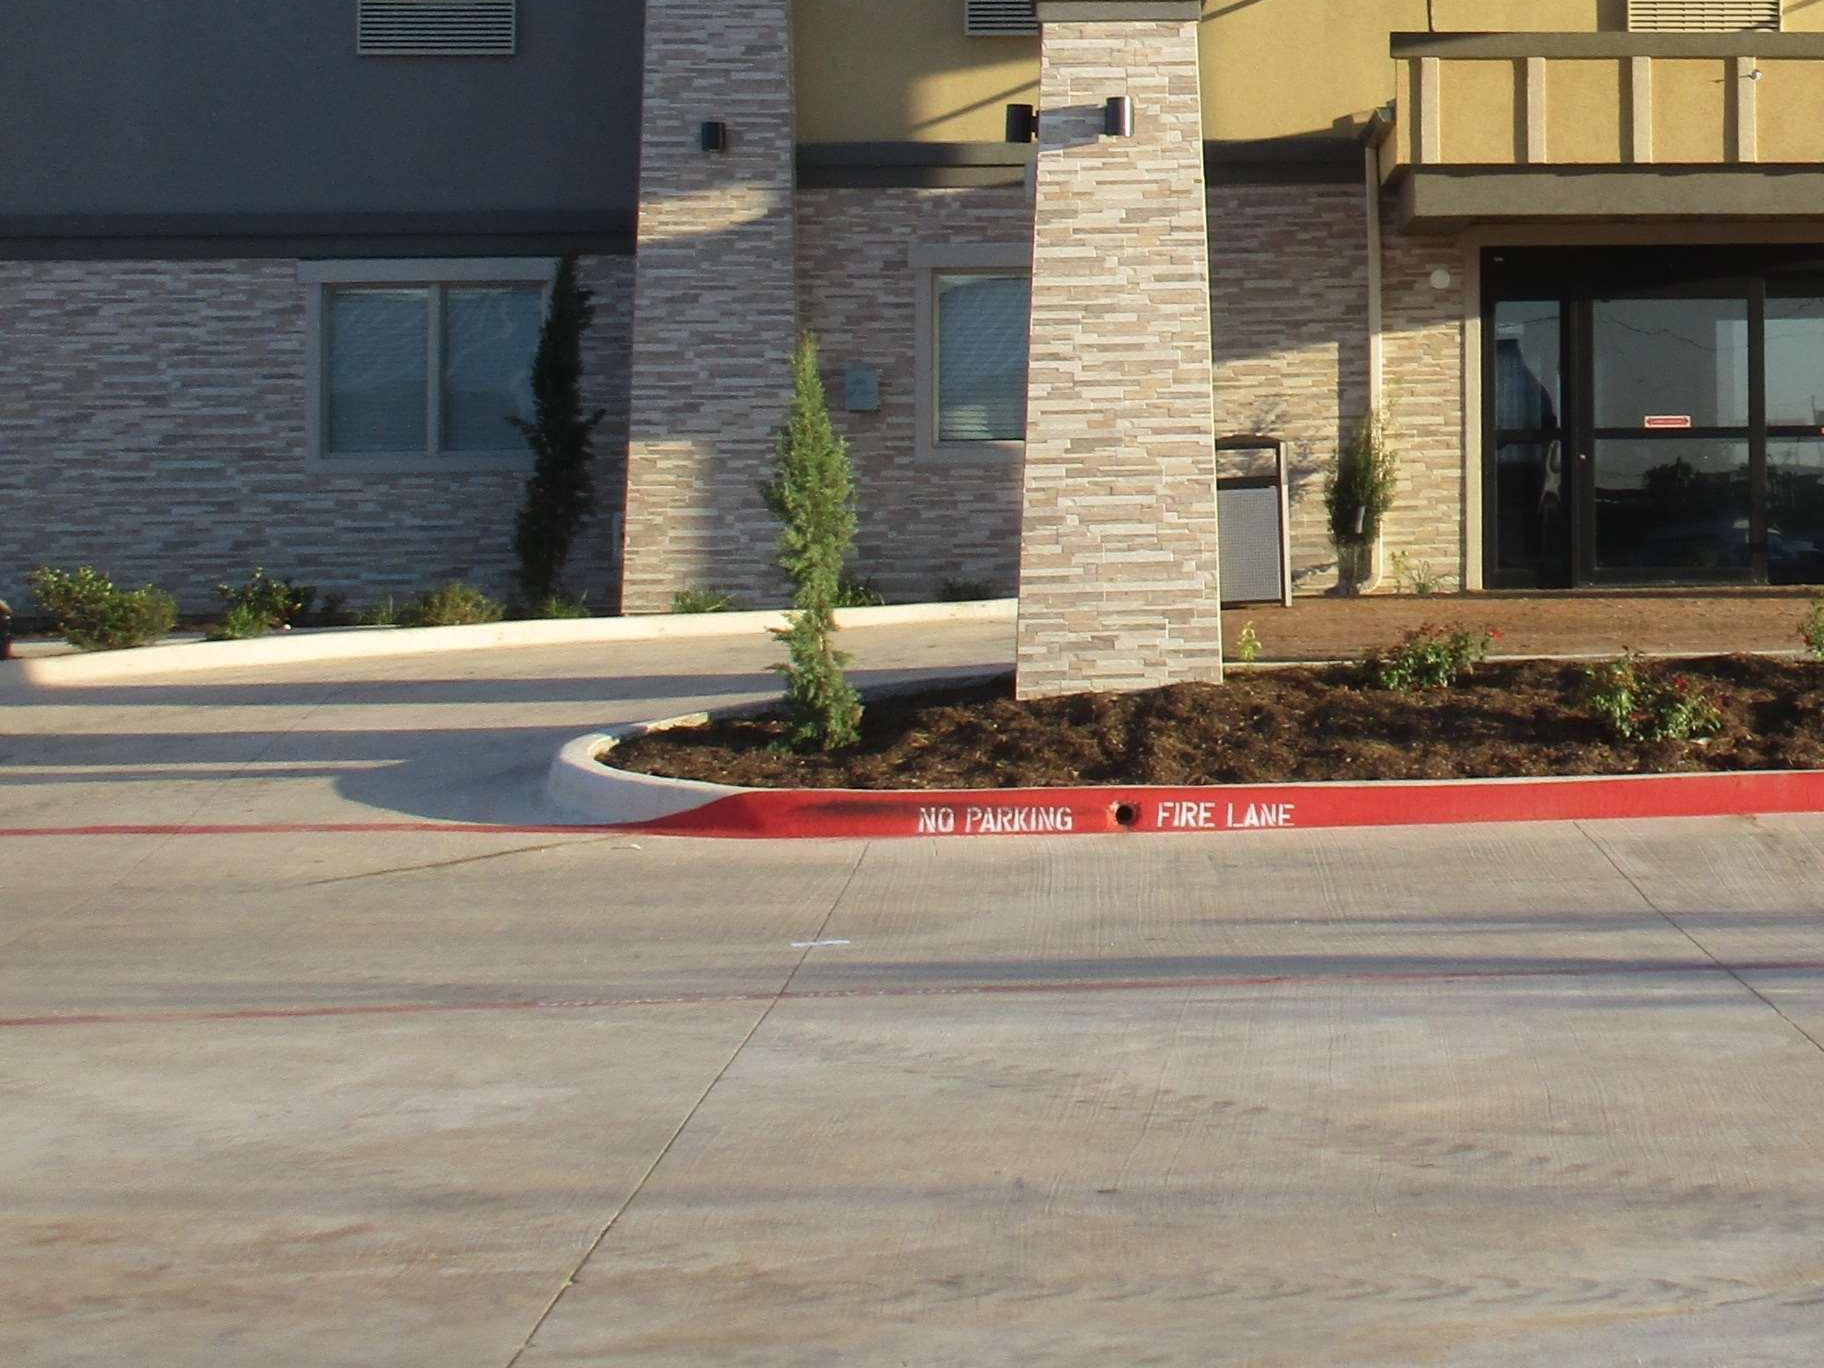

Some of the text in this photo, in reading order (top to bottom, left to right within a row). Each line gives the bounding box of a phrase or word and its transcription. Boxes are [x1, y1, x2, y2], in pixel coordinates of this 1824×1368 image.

[917, 801, 1296, 833] NO PARKING FIRE LANE
